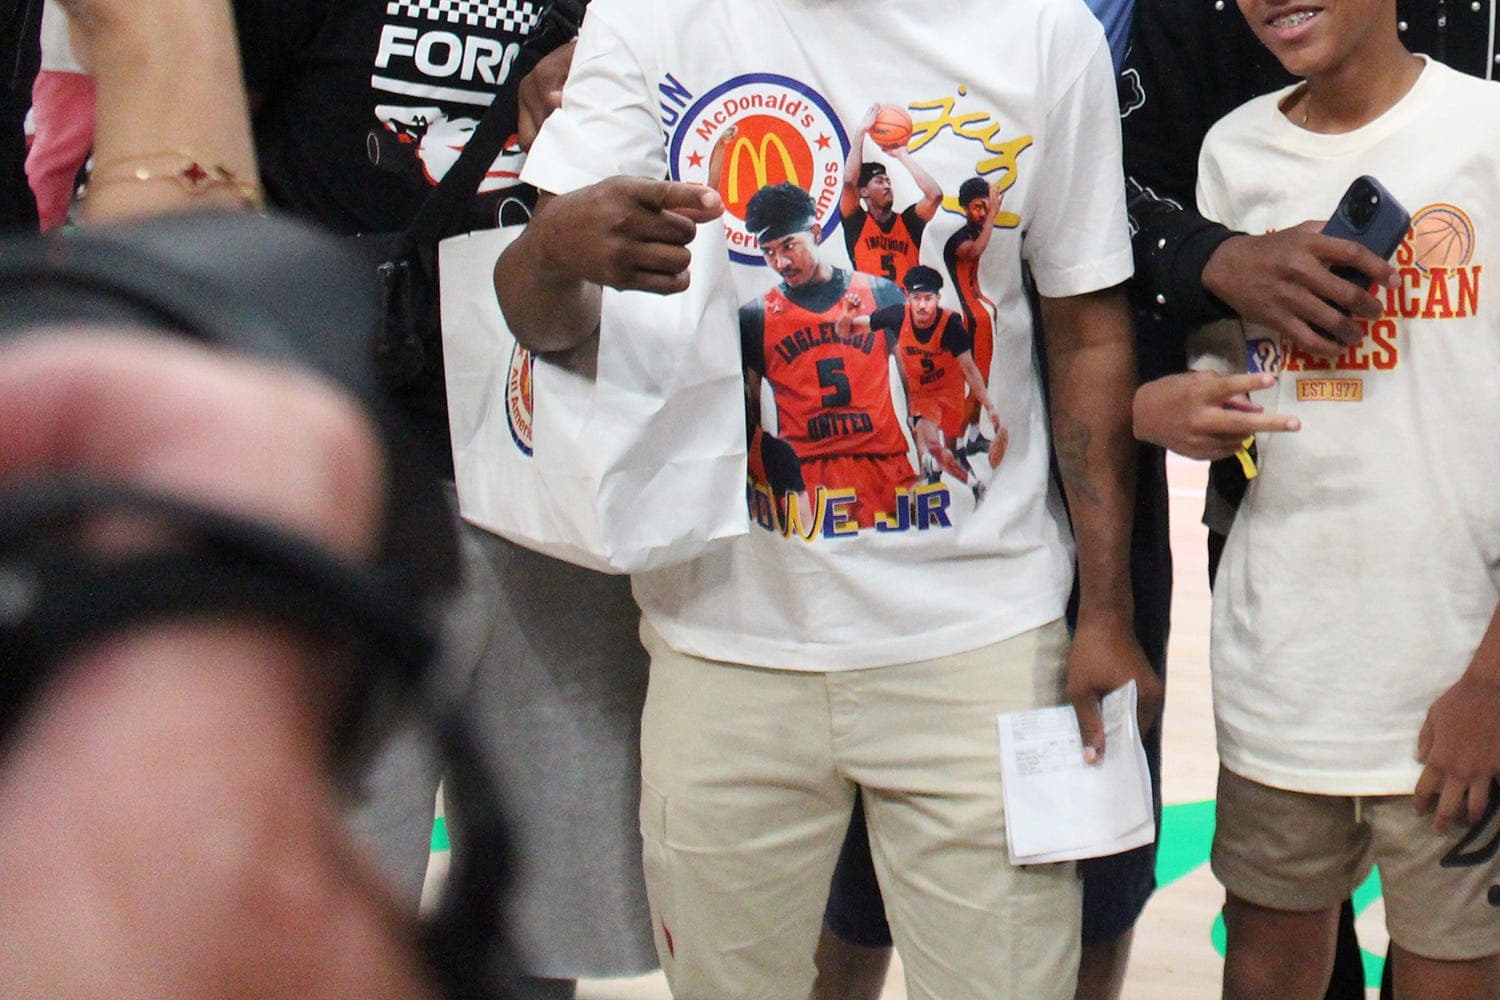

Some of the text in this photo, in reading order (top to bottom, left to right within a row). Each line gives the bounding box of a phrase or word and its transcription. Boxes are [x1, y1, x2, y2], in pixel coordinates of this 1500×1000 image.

[696, 94, 815, 142] McDonald's
[815, 356, 851, 408] 5
[1301, 382, 1359, 398] EST 1977
[807, 411, 874, 441] UNITED
[874, 480, 952, 532] JR
